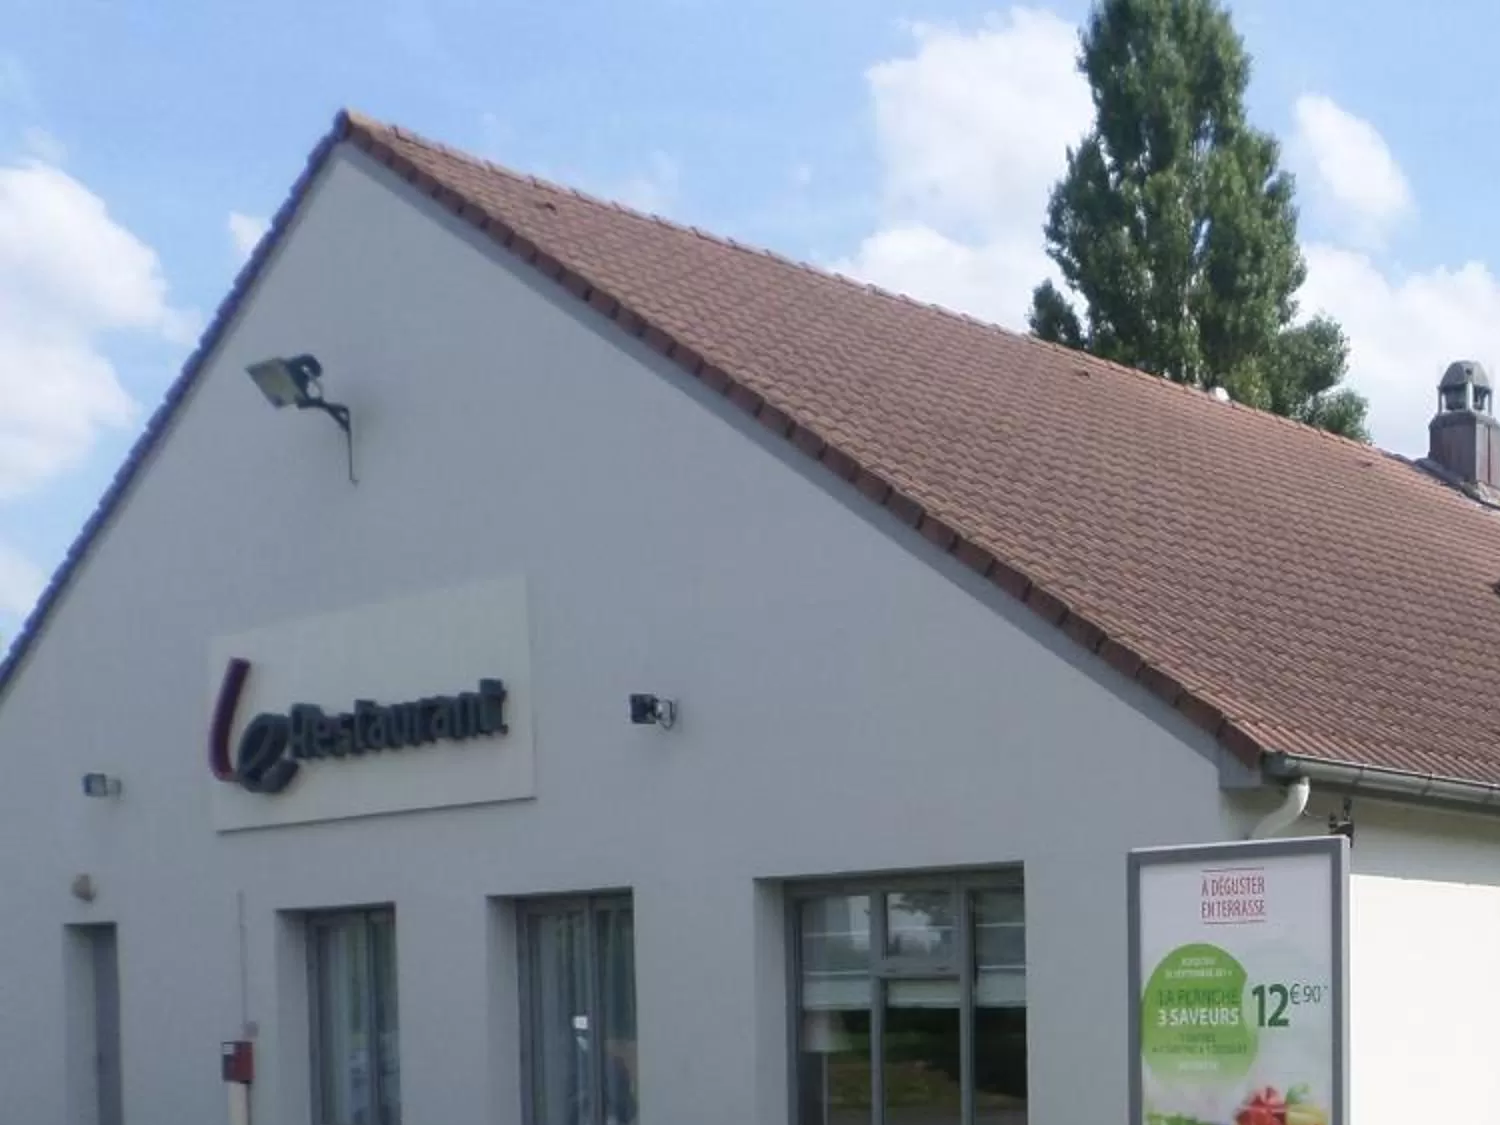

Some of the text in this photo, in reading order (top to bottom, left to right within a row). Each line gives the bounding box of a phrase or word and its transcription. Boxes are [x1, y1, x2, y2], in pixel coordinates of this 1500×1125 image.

[290, 677, 508, 760] Restaurant
[1215, 899, 1265, 918] TERRASSE
[1157, 1007, 1240, 1026] 3 SAVEURS
